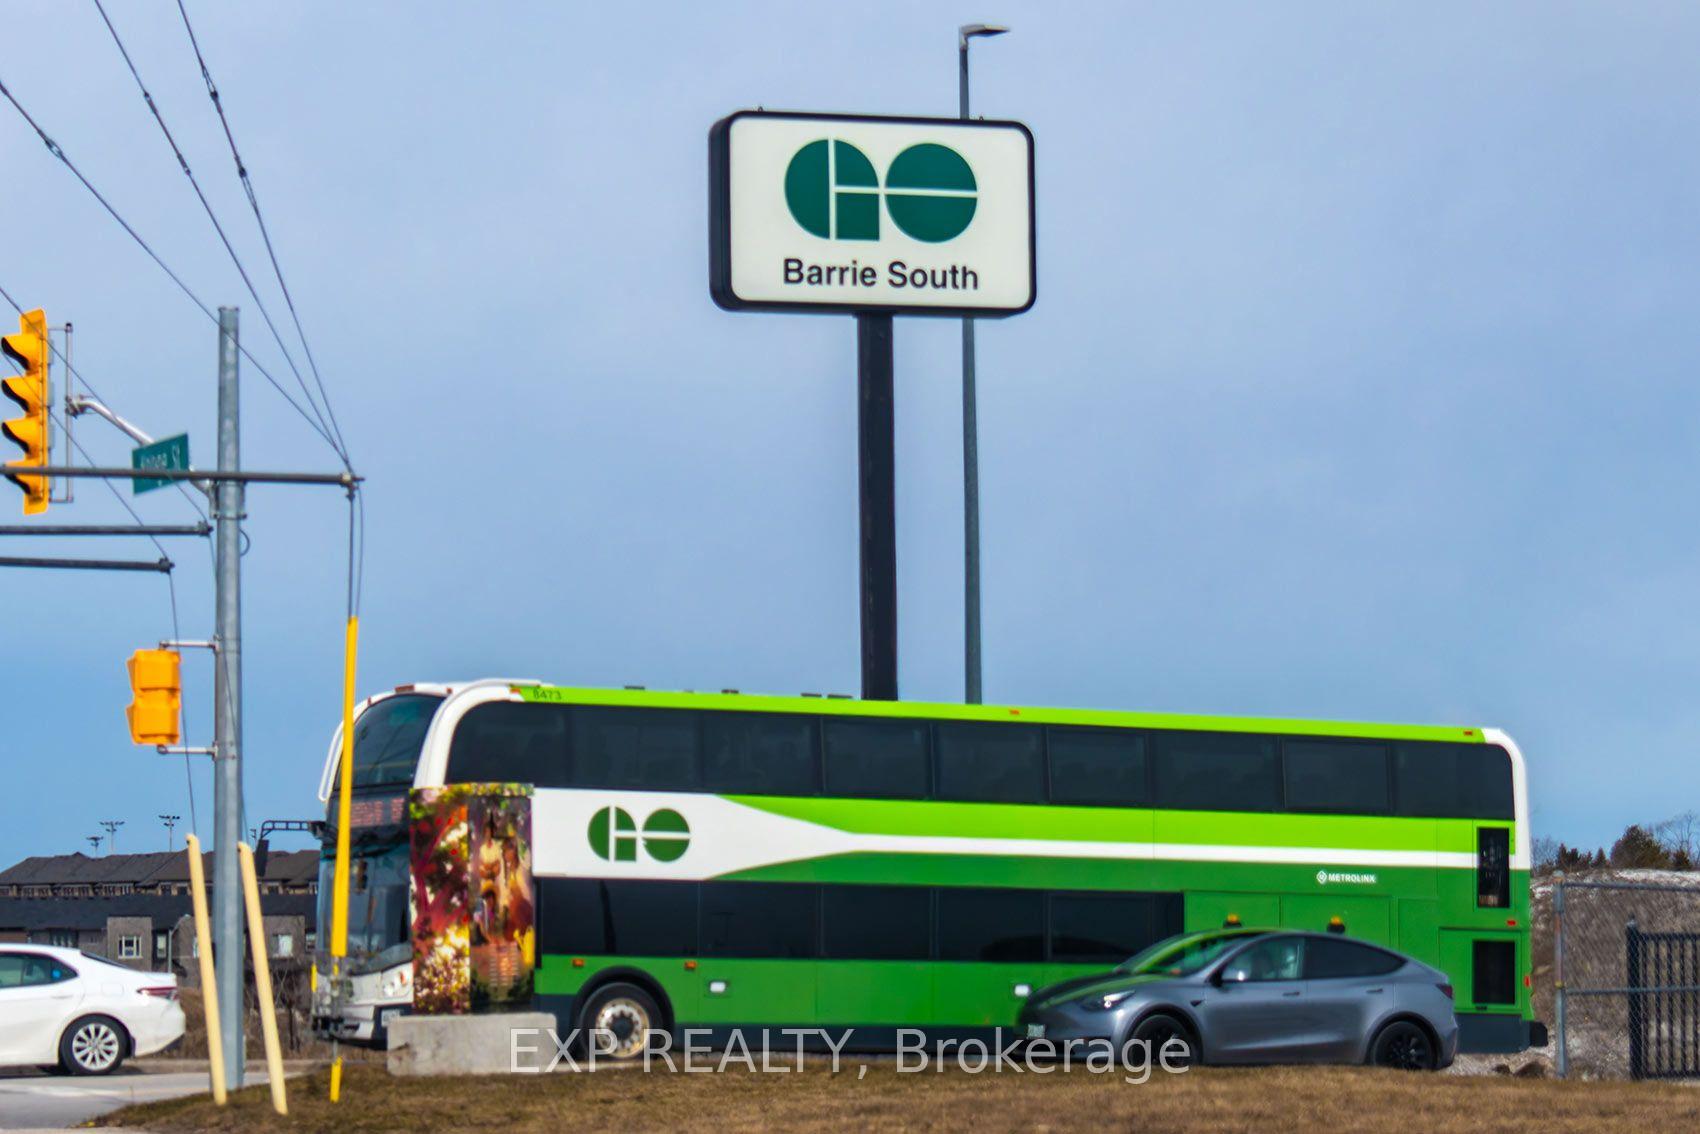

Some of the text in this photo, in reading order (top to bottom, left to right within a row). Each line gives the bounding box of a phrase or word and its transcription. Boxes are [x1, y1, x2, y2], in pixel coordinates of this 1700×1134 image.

[784, 138, 978, 243] GO
[783, 257, 979, 290] Barrie South
[587, 805, 691, 863] GO
[1328, 873, 1377, 883] METROLINX
